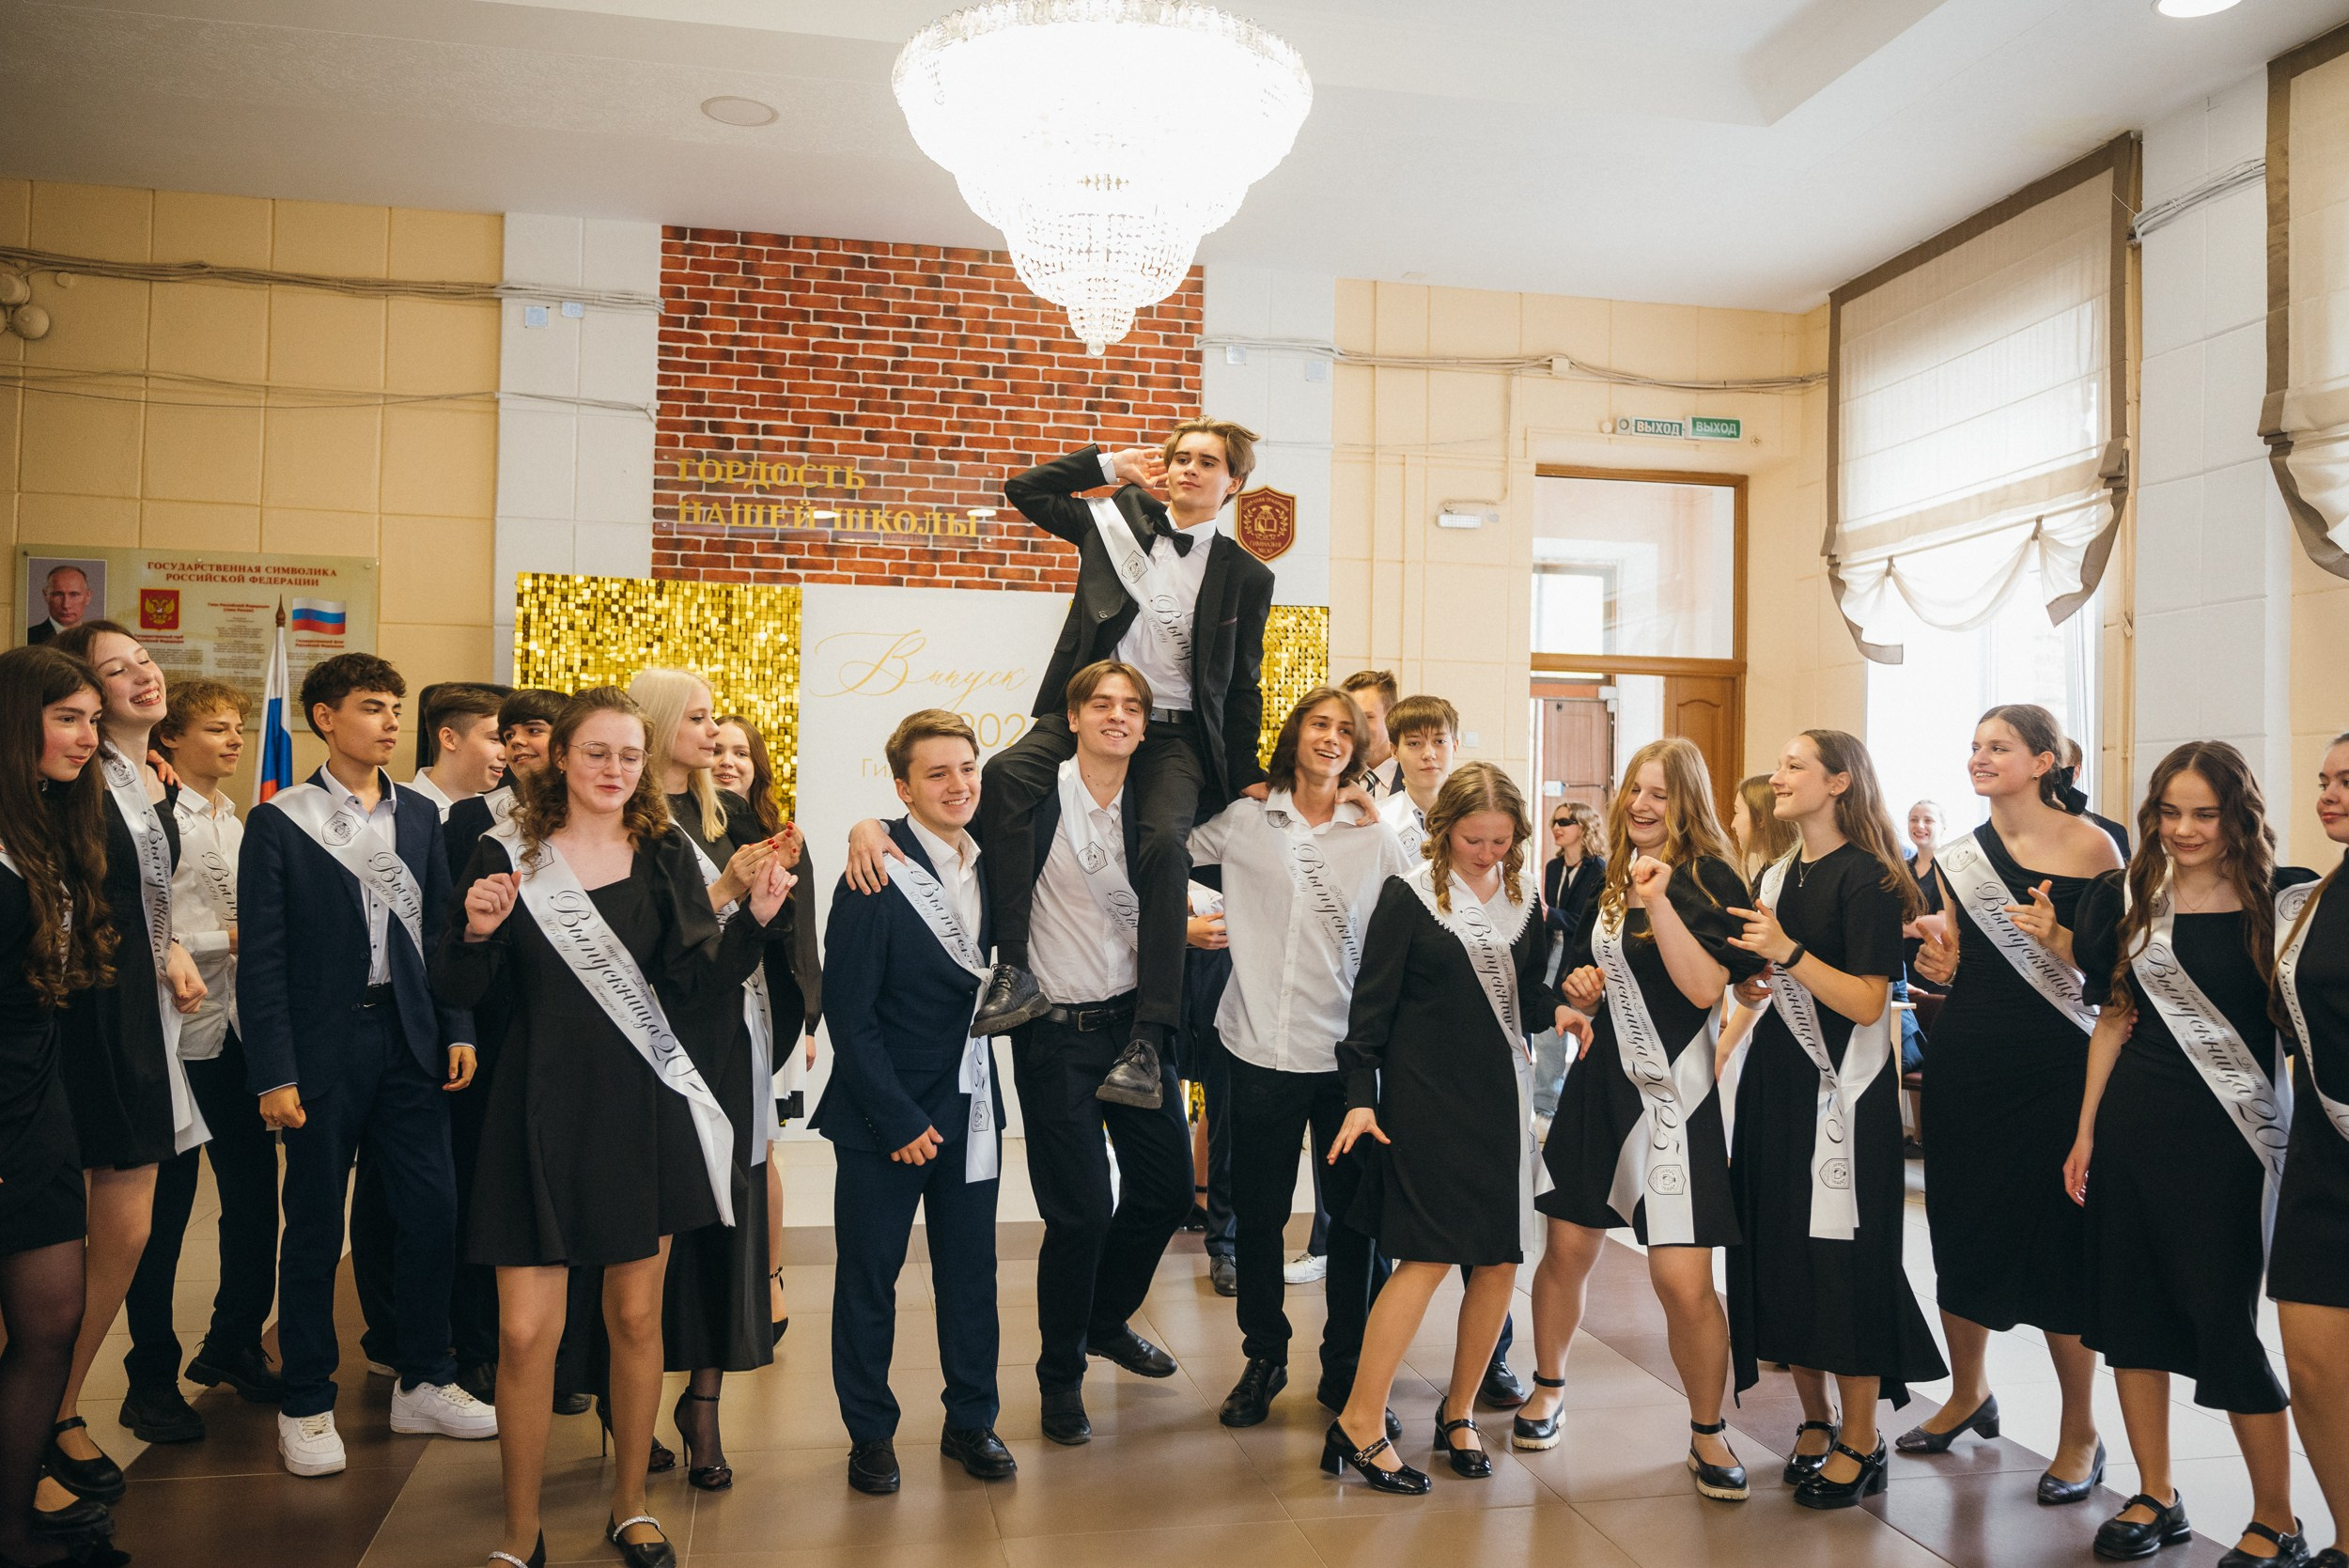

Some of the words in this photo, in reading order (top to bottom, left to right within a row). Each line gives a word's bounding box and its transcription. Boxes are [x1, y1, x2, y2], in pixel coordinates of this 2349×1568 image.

[1636, 421, 1680, 436] ВЫХОД
[1696, 421, 1737, 436] ВЫХОД
[677, 458, 865, 490] ГОРДОСТЬ
[677, 500, 817, 530] НАШЕЙ
[834, 510, 977, 538] ШКОЛЫ
[148, 561, 261, 574] ГОСУДАРСТВЕННАЯ
[265, 566, 337, 577] СИМВОЛИКА
[165, 572, 245, 583] РОССИЙСКОЙ
[249, 577, 319, 587] ФЕДЕРАЦИИ
[809, 629, 1030, 712] Выпуск
[540, 915, 573, 952] МБОУ
[1973, 881, 2084, 1005] Выпускница
[547, 890, 661, 1038] Выпускница
[2143, 942, 2252, 1097] Выпускница
[2233, 1056, 2264, 1091] Диана
[1628, 1059, 1683, 1157] 2025
